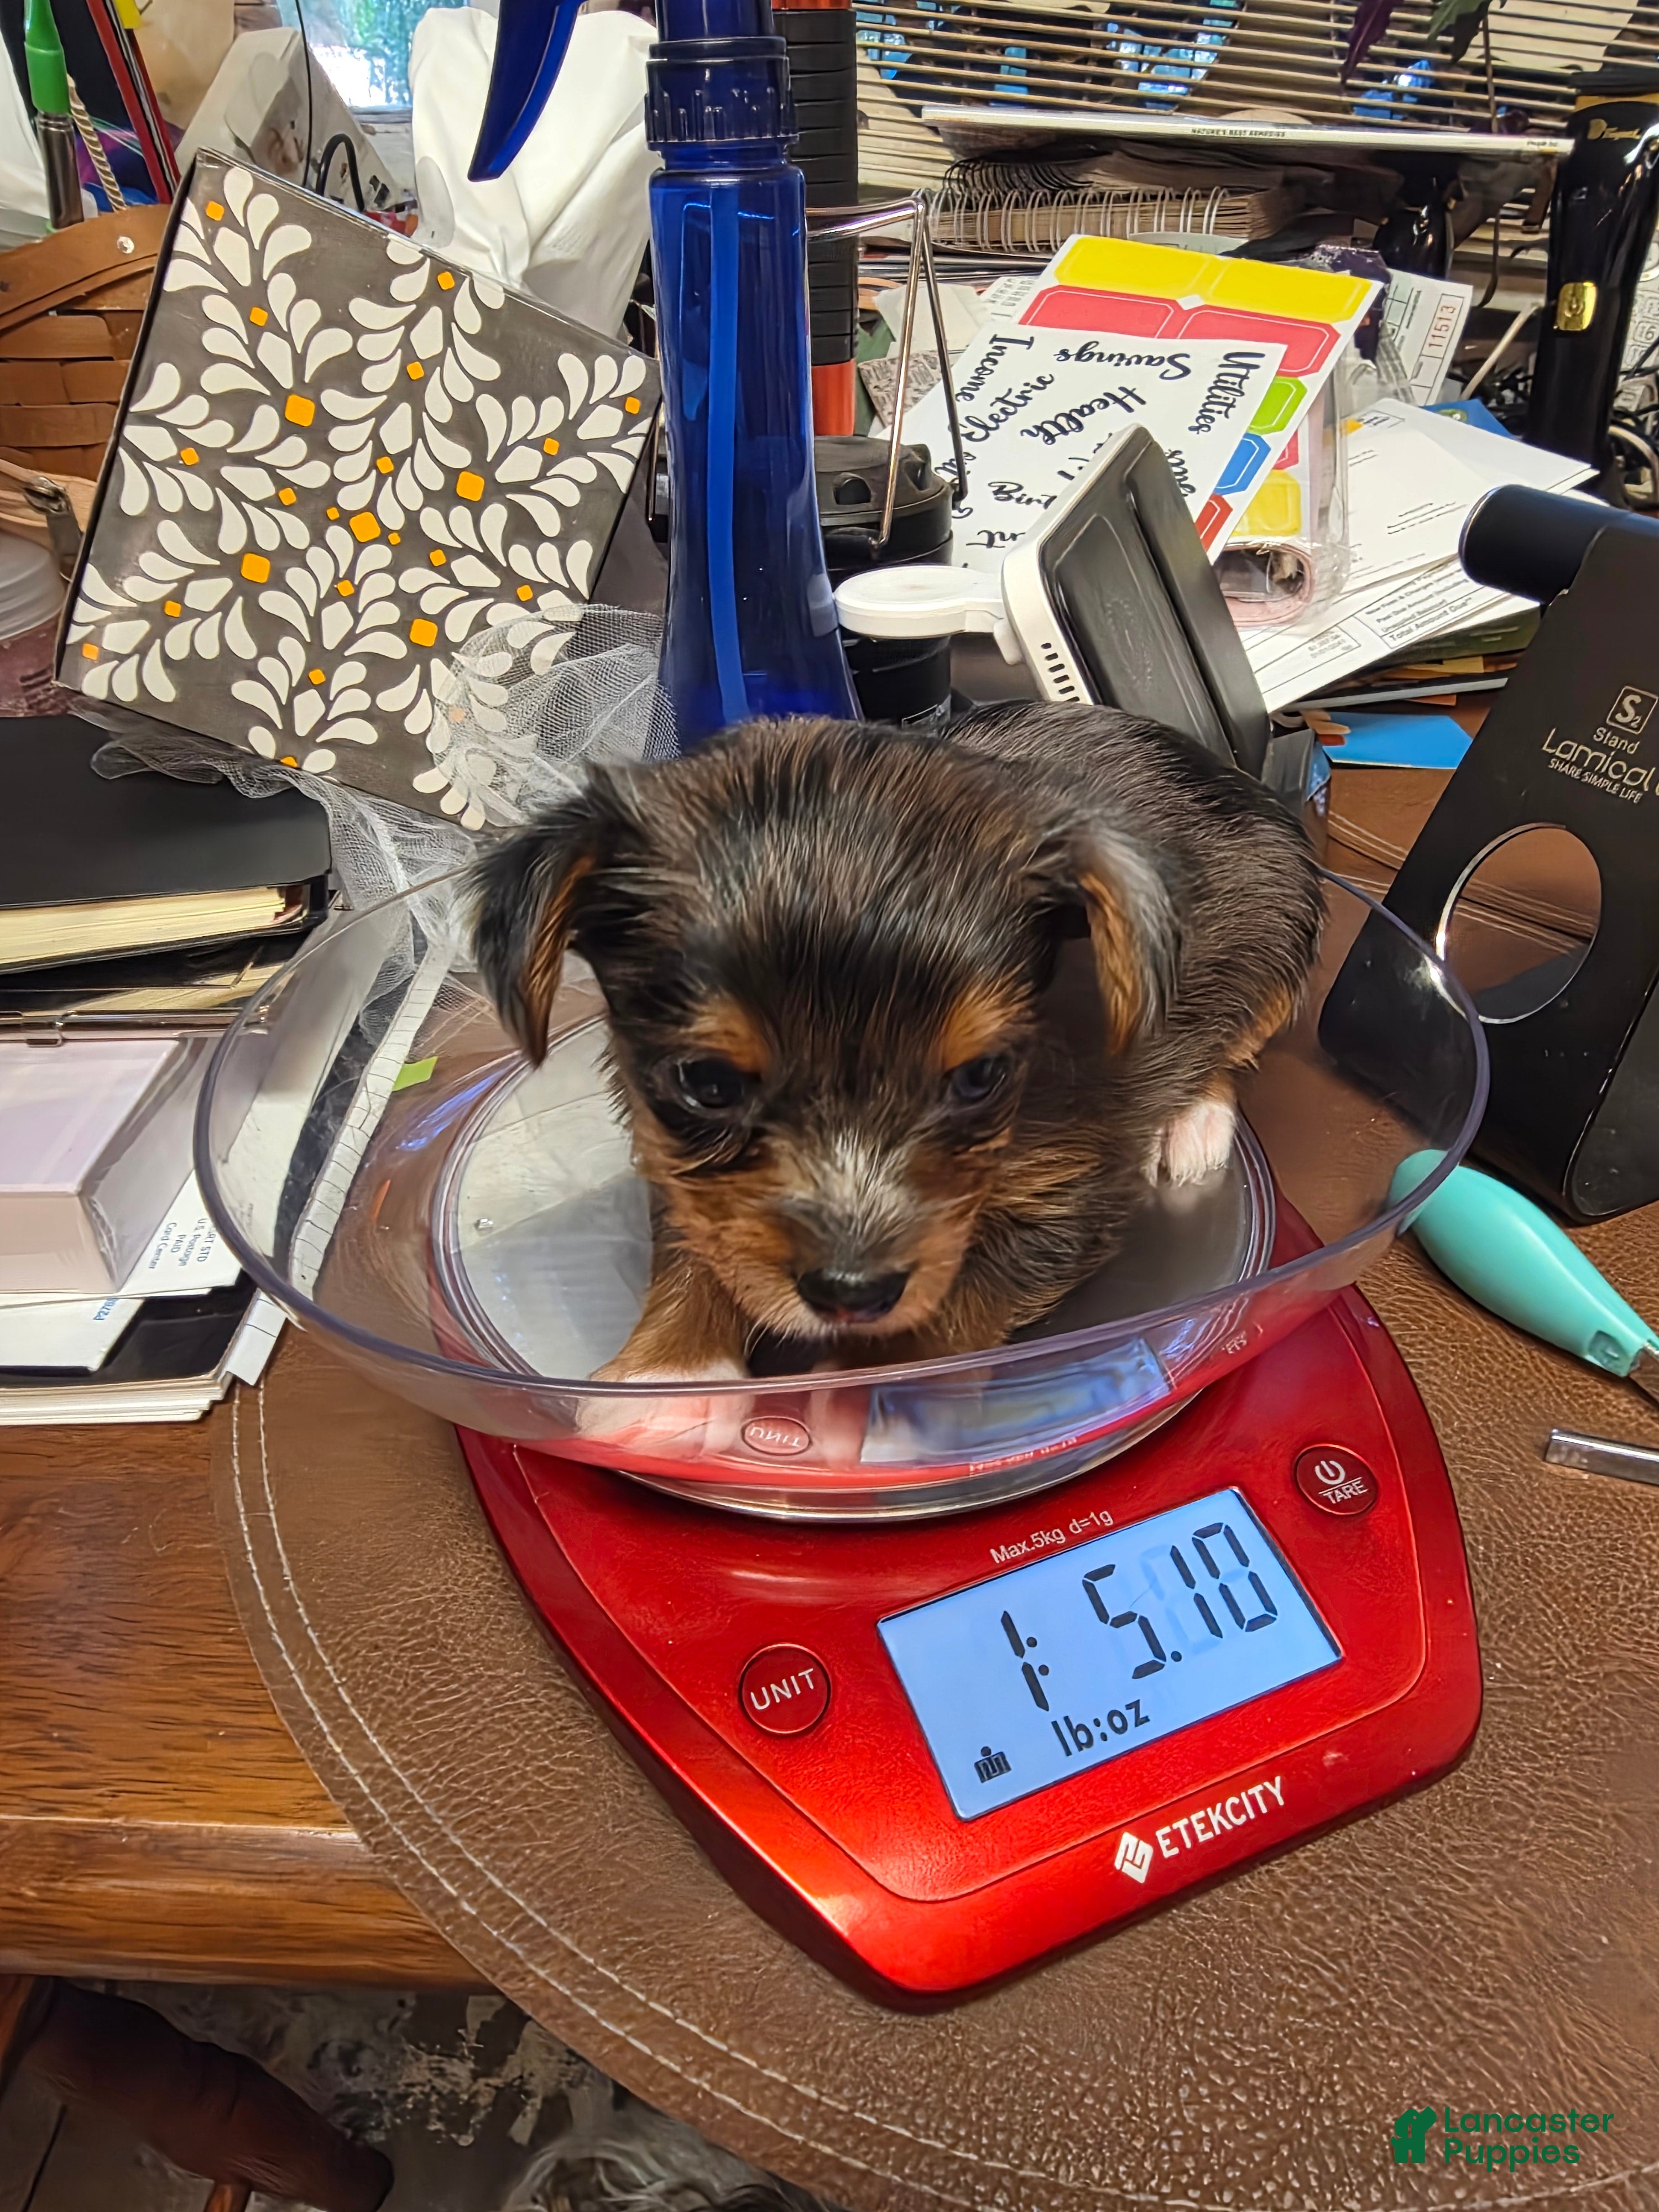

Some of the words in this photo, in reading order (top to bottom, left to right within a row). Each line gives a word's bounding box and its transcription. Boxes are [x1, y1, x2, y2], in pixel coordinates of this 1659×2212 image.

[956, 333, 1035, 402] Income
[1053, 341, 1191, 380] Savings
[949, 373, 1055, 442] Electric
[1188, 352, 1265, 435] Utilities
[1020, 387, 1146, 445] Health
[1593, 727, 1640, 754] Stand
[1548, 758, 1583, 779] SHARE
[1581, 772, 1620, 794] SIMPLE
[1619, 787, 1643, 804] LIFE
[160, 1222, 178, 1241] Card
[171, 1234, 187, 1253] PAID
[1322, 1480, 1369, 1504] TARE
[1068, 1510, 1114, 1535] d=1g
[750, 1667, 815, 1710] UNIT
[1052, 1699, 1151, 1757] lb:oz
[1156, 1775, 1285, 1859] ETEKCITY
